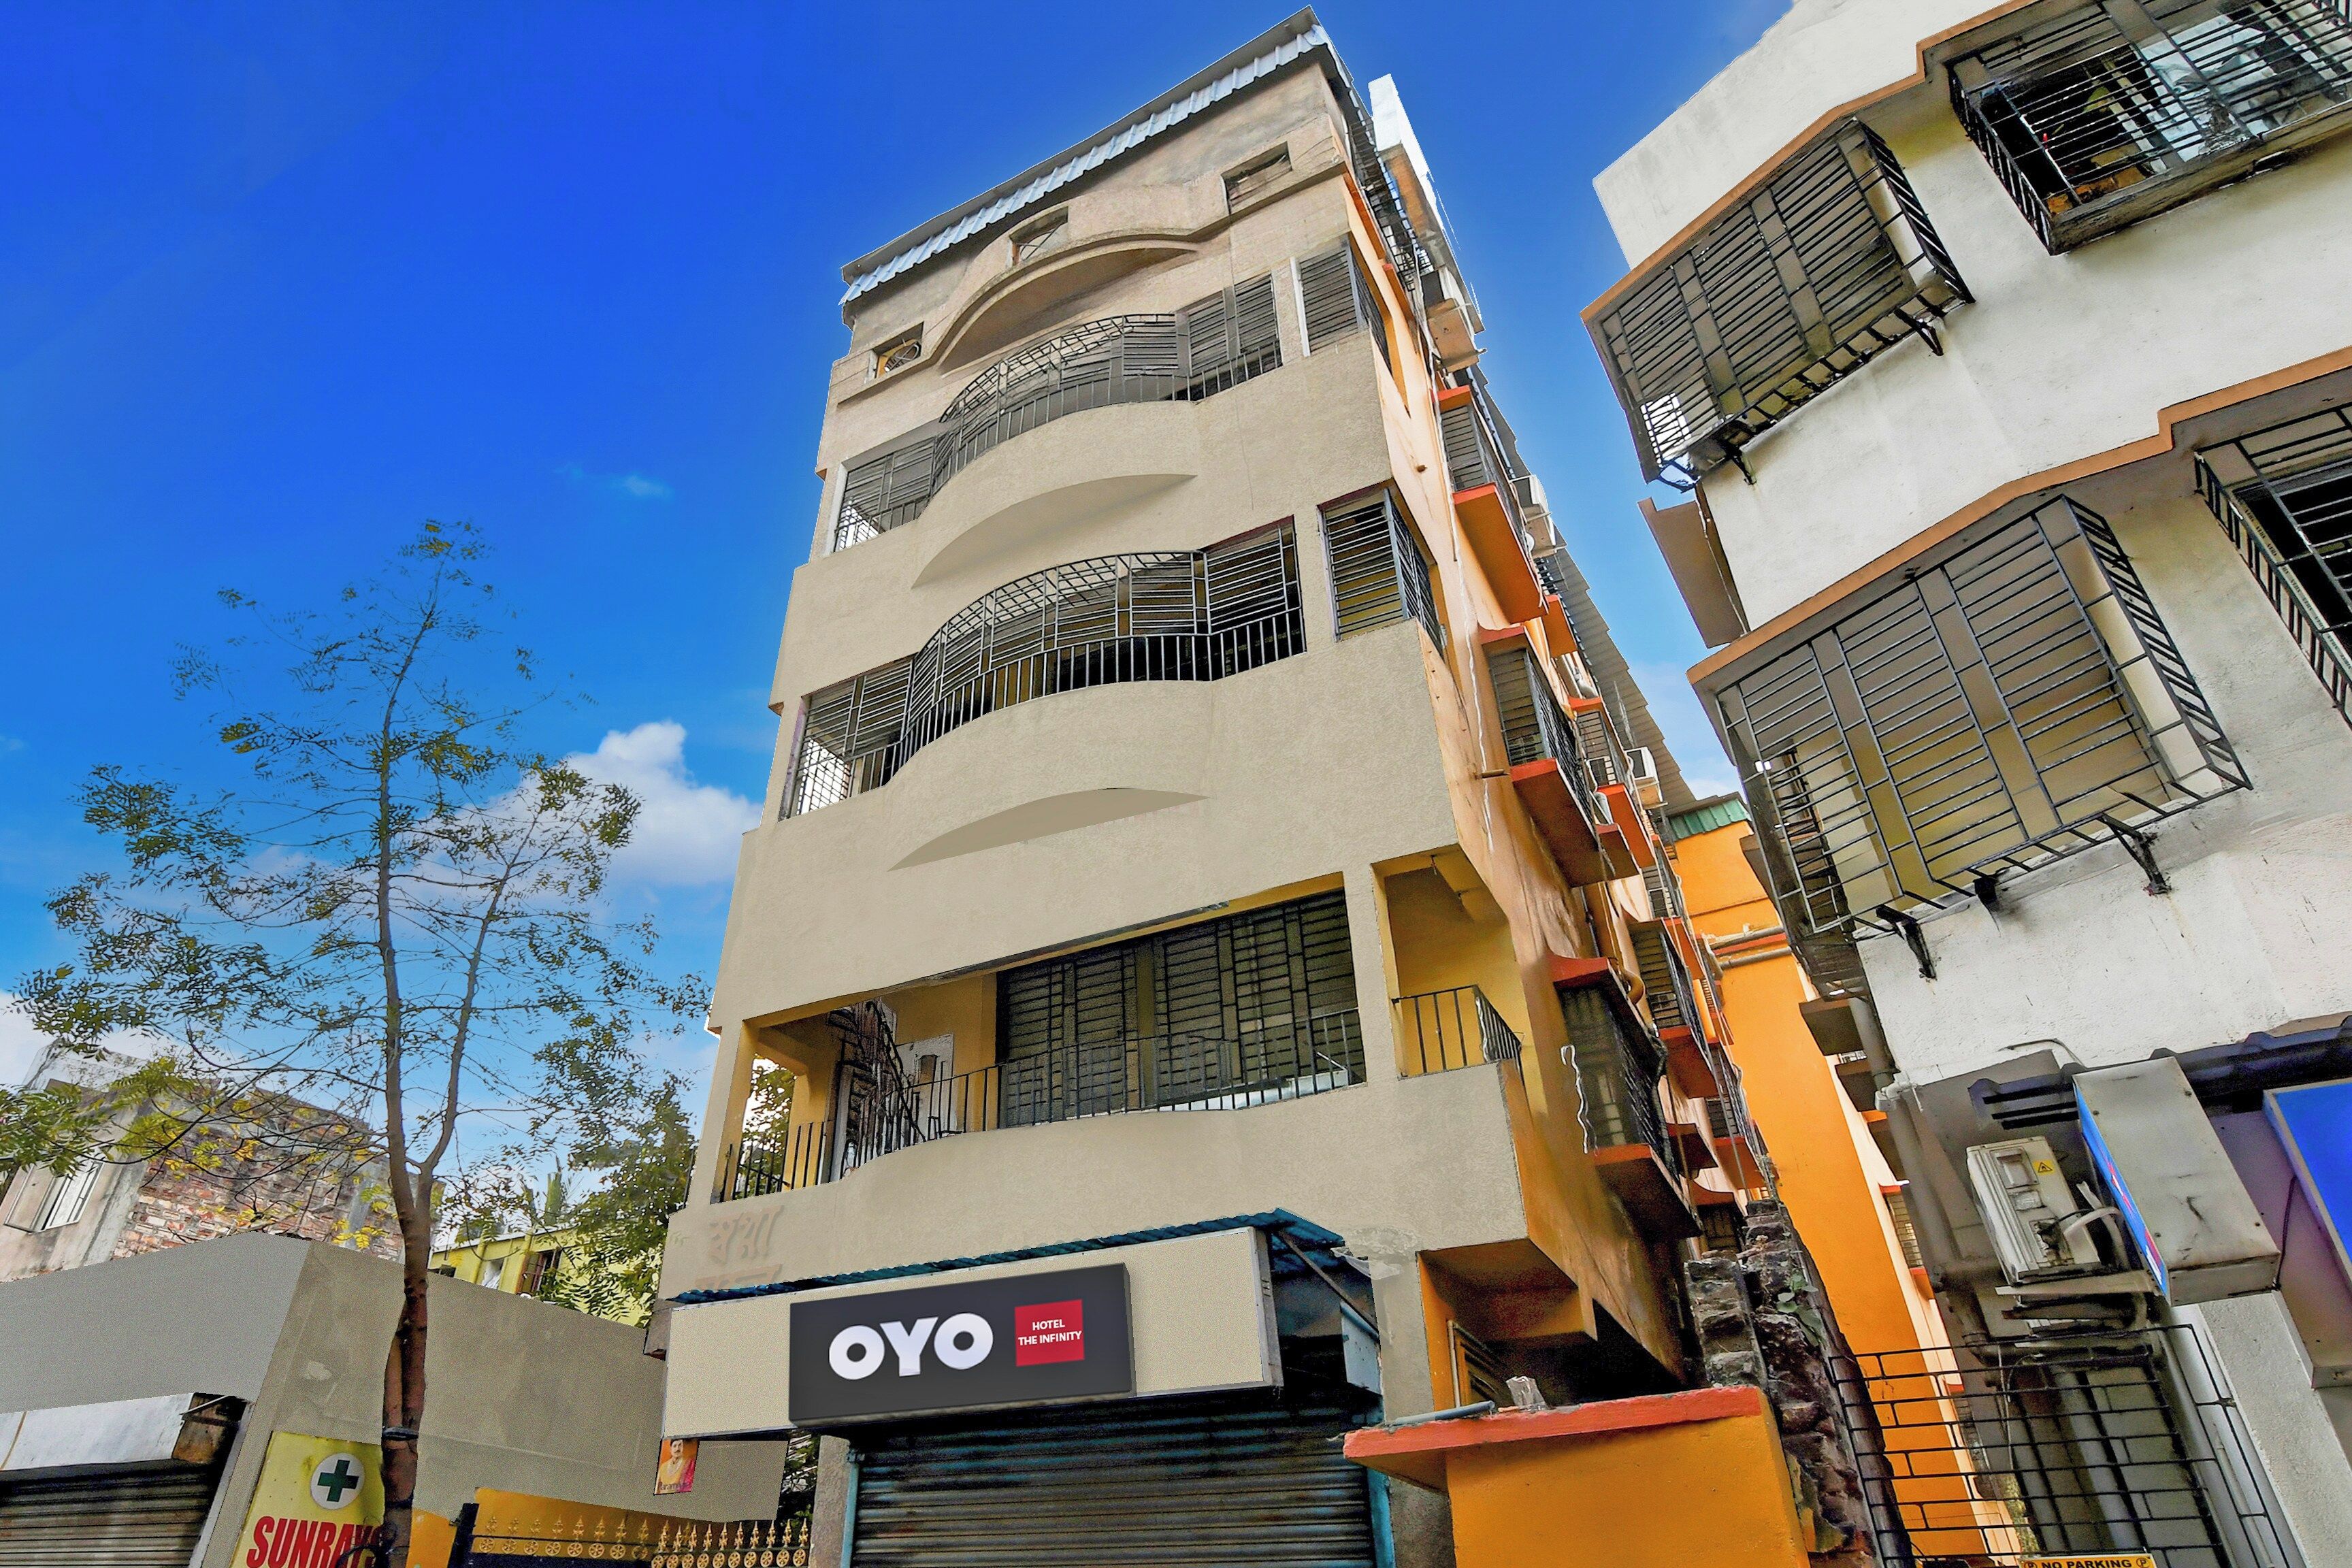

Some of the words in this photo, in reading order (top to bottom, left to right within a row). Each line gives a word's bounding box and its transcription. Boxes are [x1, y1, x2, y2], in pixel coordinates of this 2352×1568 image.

[1032, 1318, 1066, 1331] HOTEL
[1017, 1335, 1038, 1346] THE
[1039, 1330, 1082, 1344] INFINITY
[829, 1312, 994, 1380] OYO
[2066, 1559, 2132, 1568] PARKING
